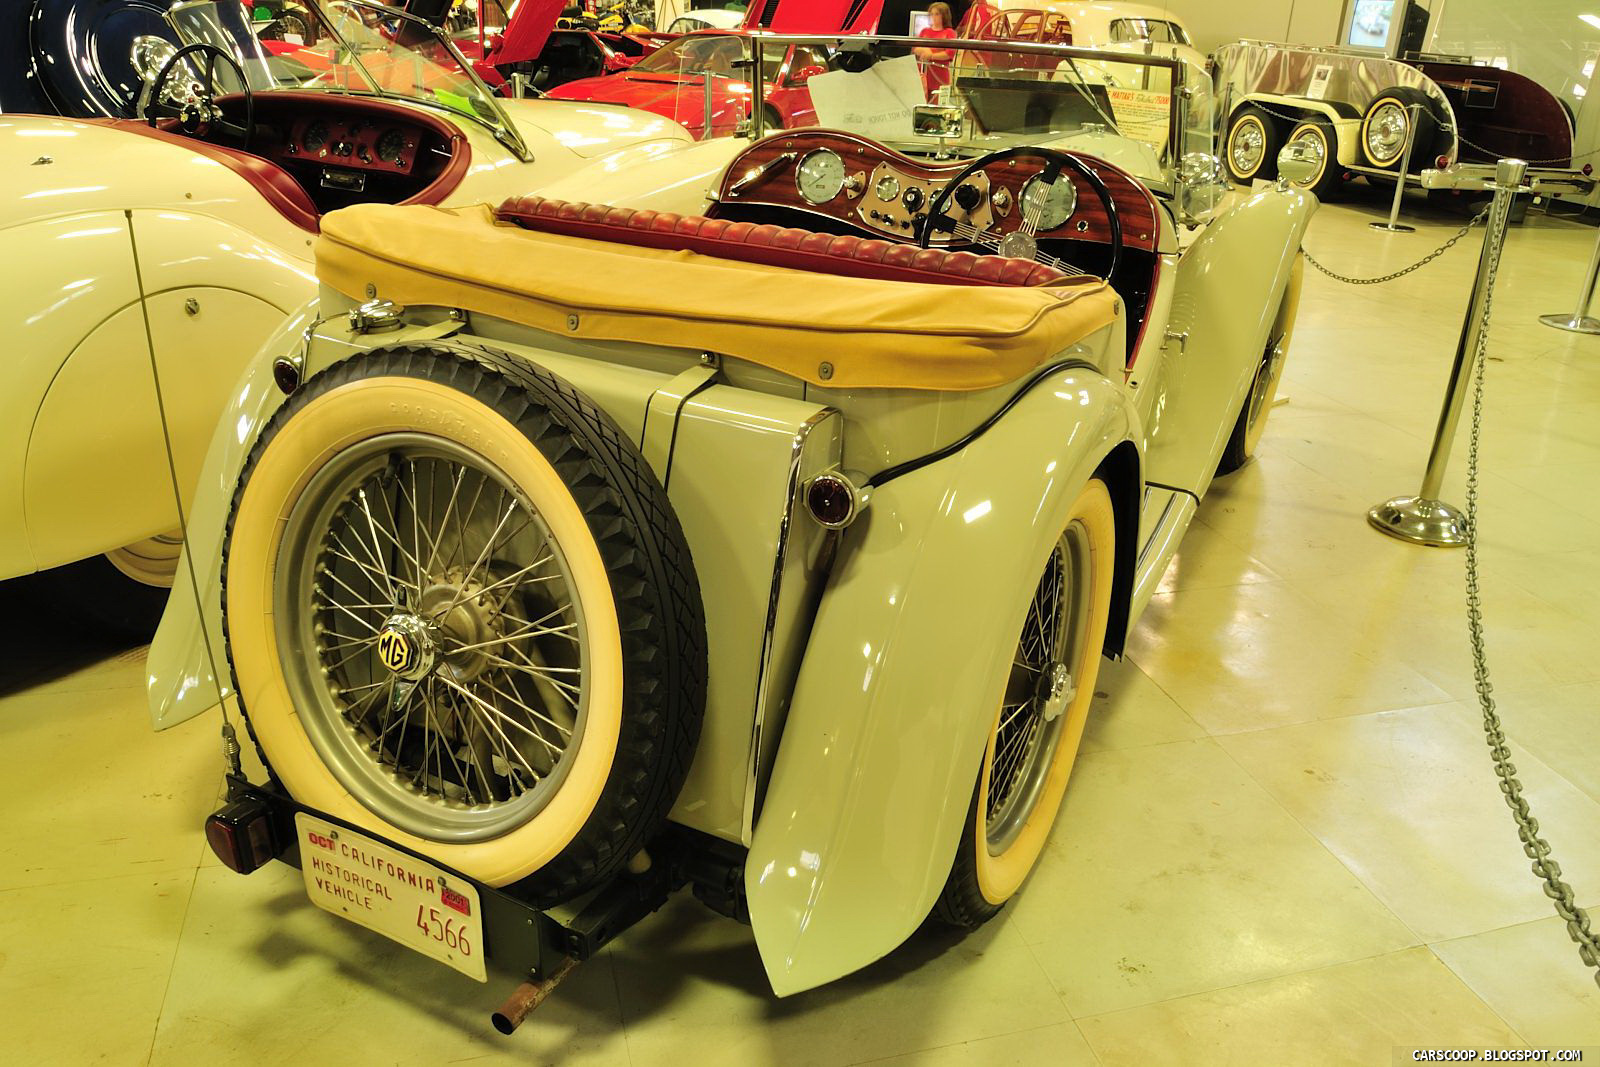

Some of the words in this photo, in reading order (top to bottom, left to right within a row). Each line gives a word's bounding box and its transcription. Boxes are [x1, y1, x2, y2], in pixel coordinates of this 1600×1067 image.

[380, 635, 405, 667] MG
[308, 832, 334, 850] OCT
[341, 843, 434, 894] CALIFORNIA
[312, 856, 392, 901] HISTORICAL
[315, 876, 372, 910] VEHICLE
[417, 904, 470, 956] 4566
